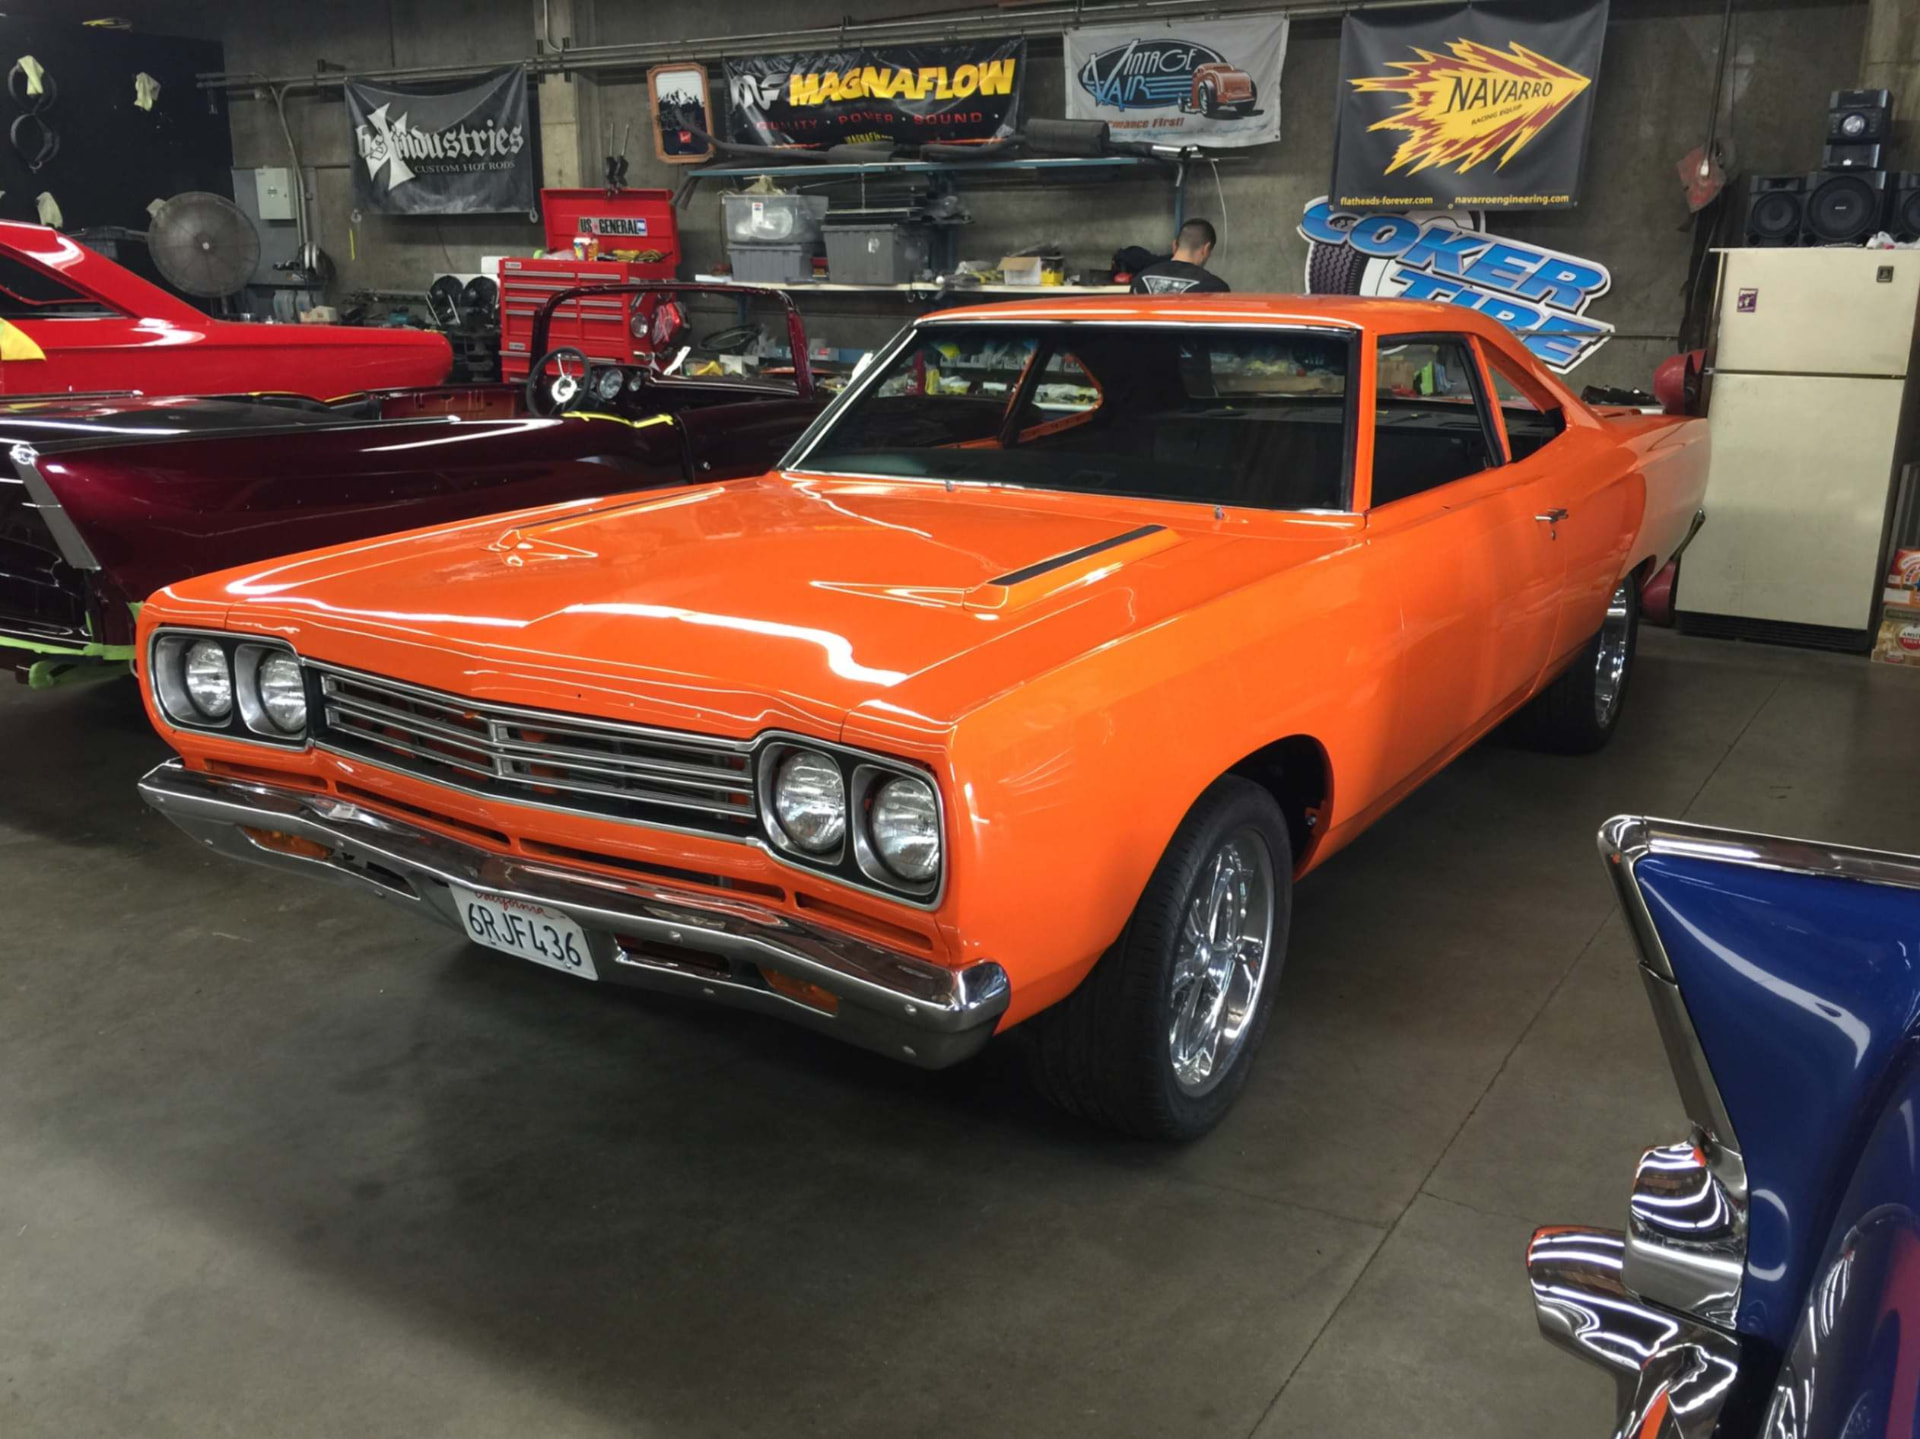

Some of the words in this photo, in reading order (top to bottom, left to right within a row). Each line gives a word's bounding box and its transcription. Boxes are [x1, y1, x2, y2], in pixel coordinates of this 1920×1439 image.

[789, 58, 1016, 107] MAGNAFLOW
[1104, 75, 1152, 112] AIR
[1437, 76, 1553, 115] NAVARRO
[756, 119, 817, 130] QUITY
[913, 112, 982, 125] SOUND
[1106, 119, 1149, 129] rmance
[1471, 111, 1499, 126] RACING
[414, 163, 460, 174] CUSTOM
[462, 162, 486, 172] HOT
[488, 161, 515, 171] RODS
[1340, 195, 1434, 206] flatheads-forever.com
[1455, 194, 1570, 206] navarroengineering.com
[580, 218, 593, 233] US
[599, 218, 639, 235] GENERAL
[1300, 203, 1608, 312] COKER
[1391, 268, 1607, 367] TRE
[468, 903, 582, 967] 6RJF436
